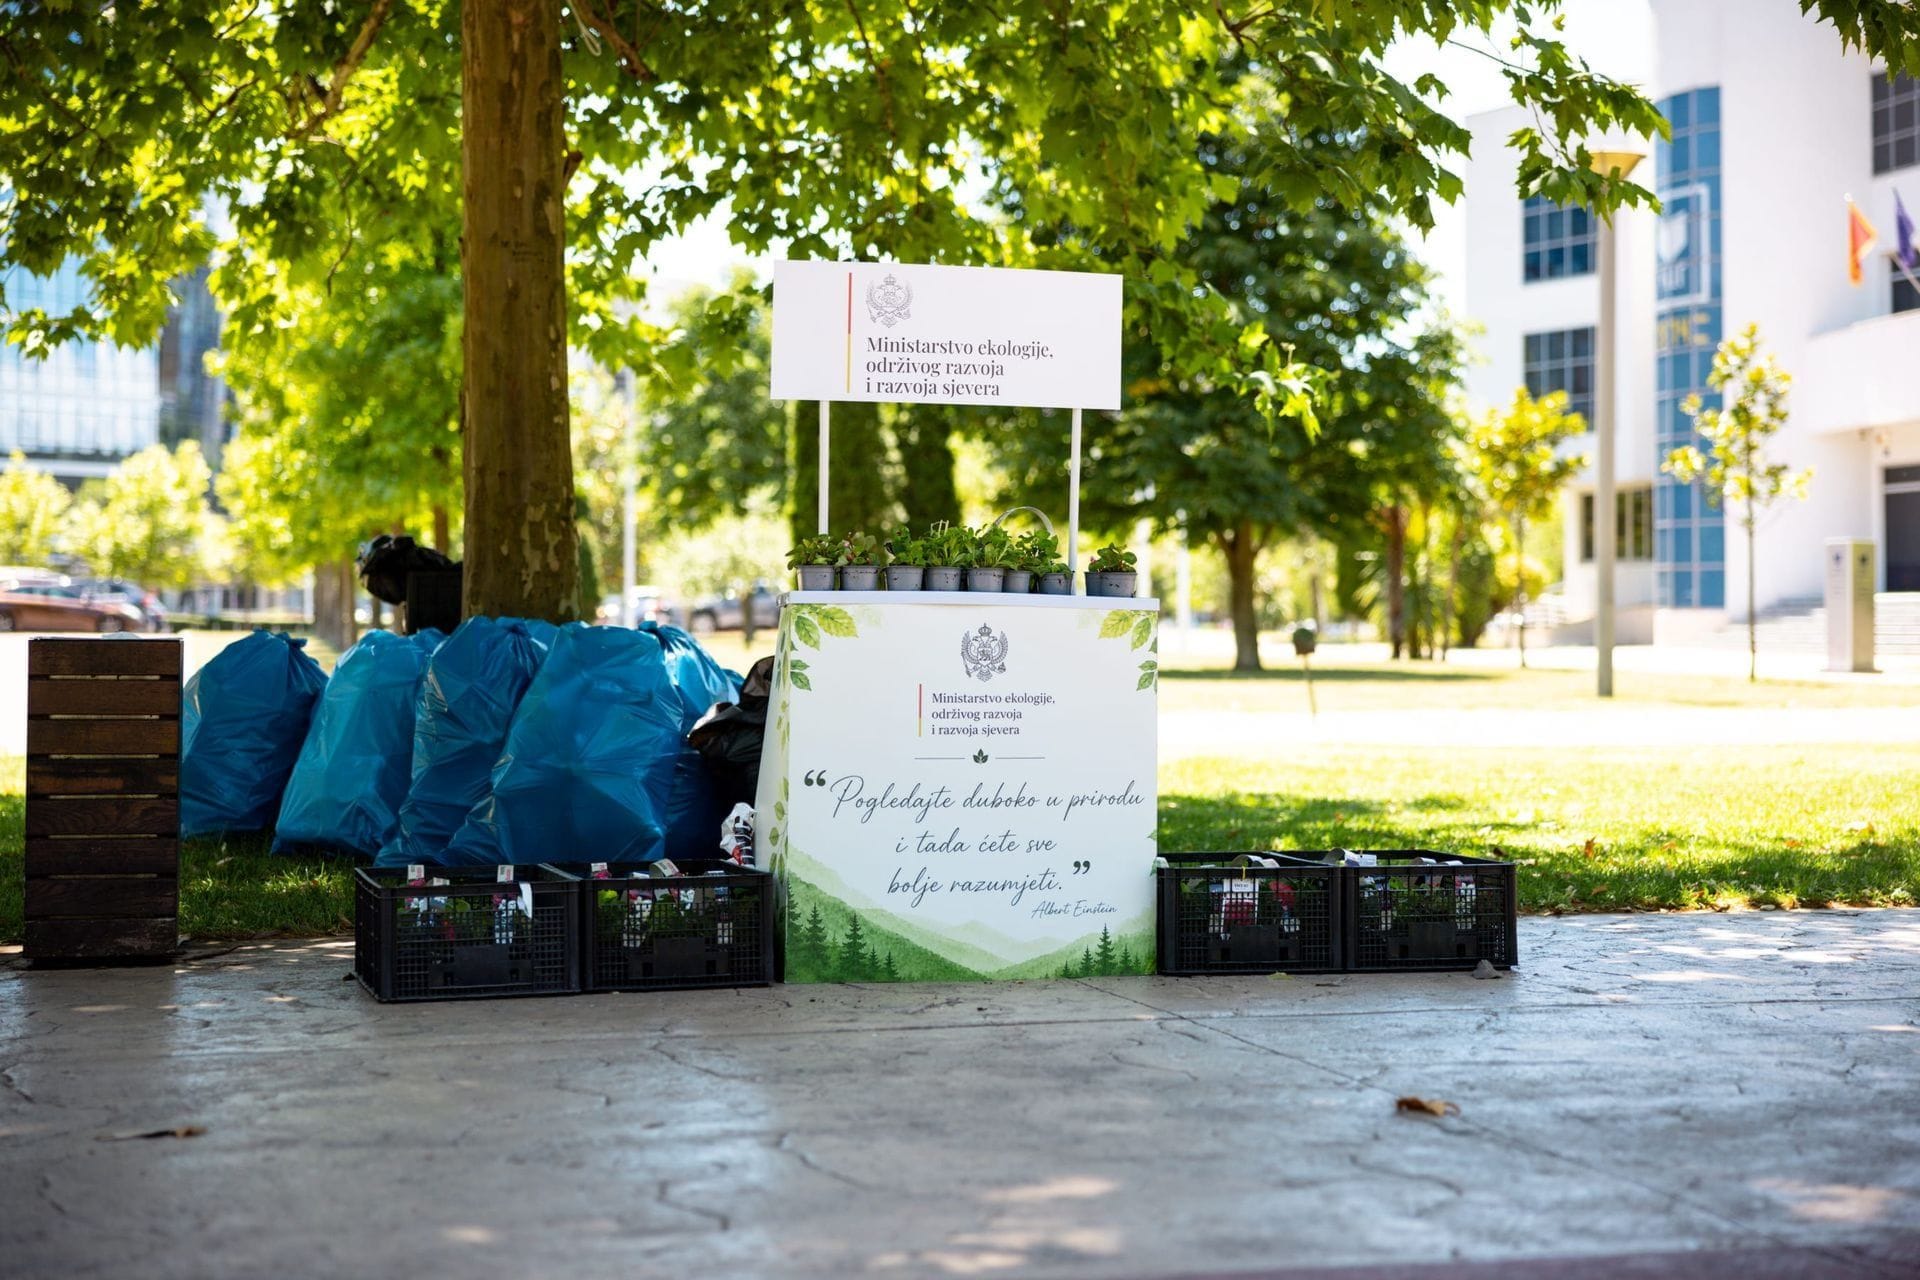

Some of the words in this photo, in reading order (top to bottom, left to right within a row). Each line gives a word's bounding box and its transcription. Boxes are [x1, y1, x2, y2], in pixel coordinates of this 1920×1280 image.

[867, 336, 974, 355] Ministarstvo
[866, 356, 941, 378] održivog
[945, 359, 1005, 379] razvoja
[866, 376, 871, 394] i
[876, 378, 938, 398] razvoja
[942, 378, 1000, 398] sjevera
[932, 692, 1002, 704] Ministarstvo
[931, 708, 981, 722] održivog
[983, 709, 1023, 722] razvoja
[931, 724, 936, 736] i
[938, 724, 979, 738] razvoja
[981, 724, 1020, 738] sjevera
[962, 781, 1041, 809] duboko
[1046, 796, 1063, 808] u
[1062, 779, 1145, 821] prirodu
[895, 836, 909, 854] i
[914, 826, 972, 854] tada
[978, 829, 1021, 854] ćete
[1026, 839, 1058, 854] sve
[886, 866, 943, 908] bolje
[1030, 900, 1071, 919] Albert
[1073, 899, 1119, 918] Einstein
